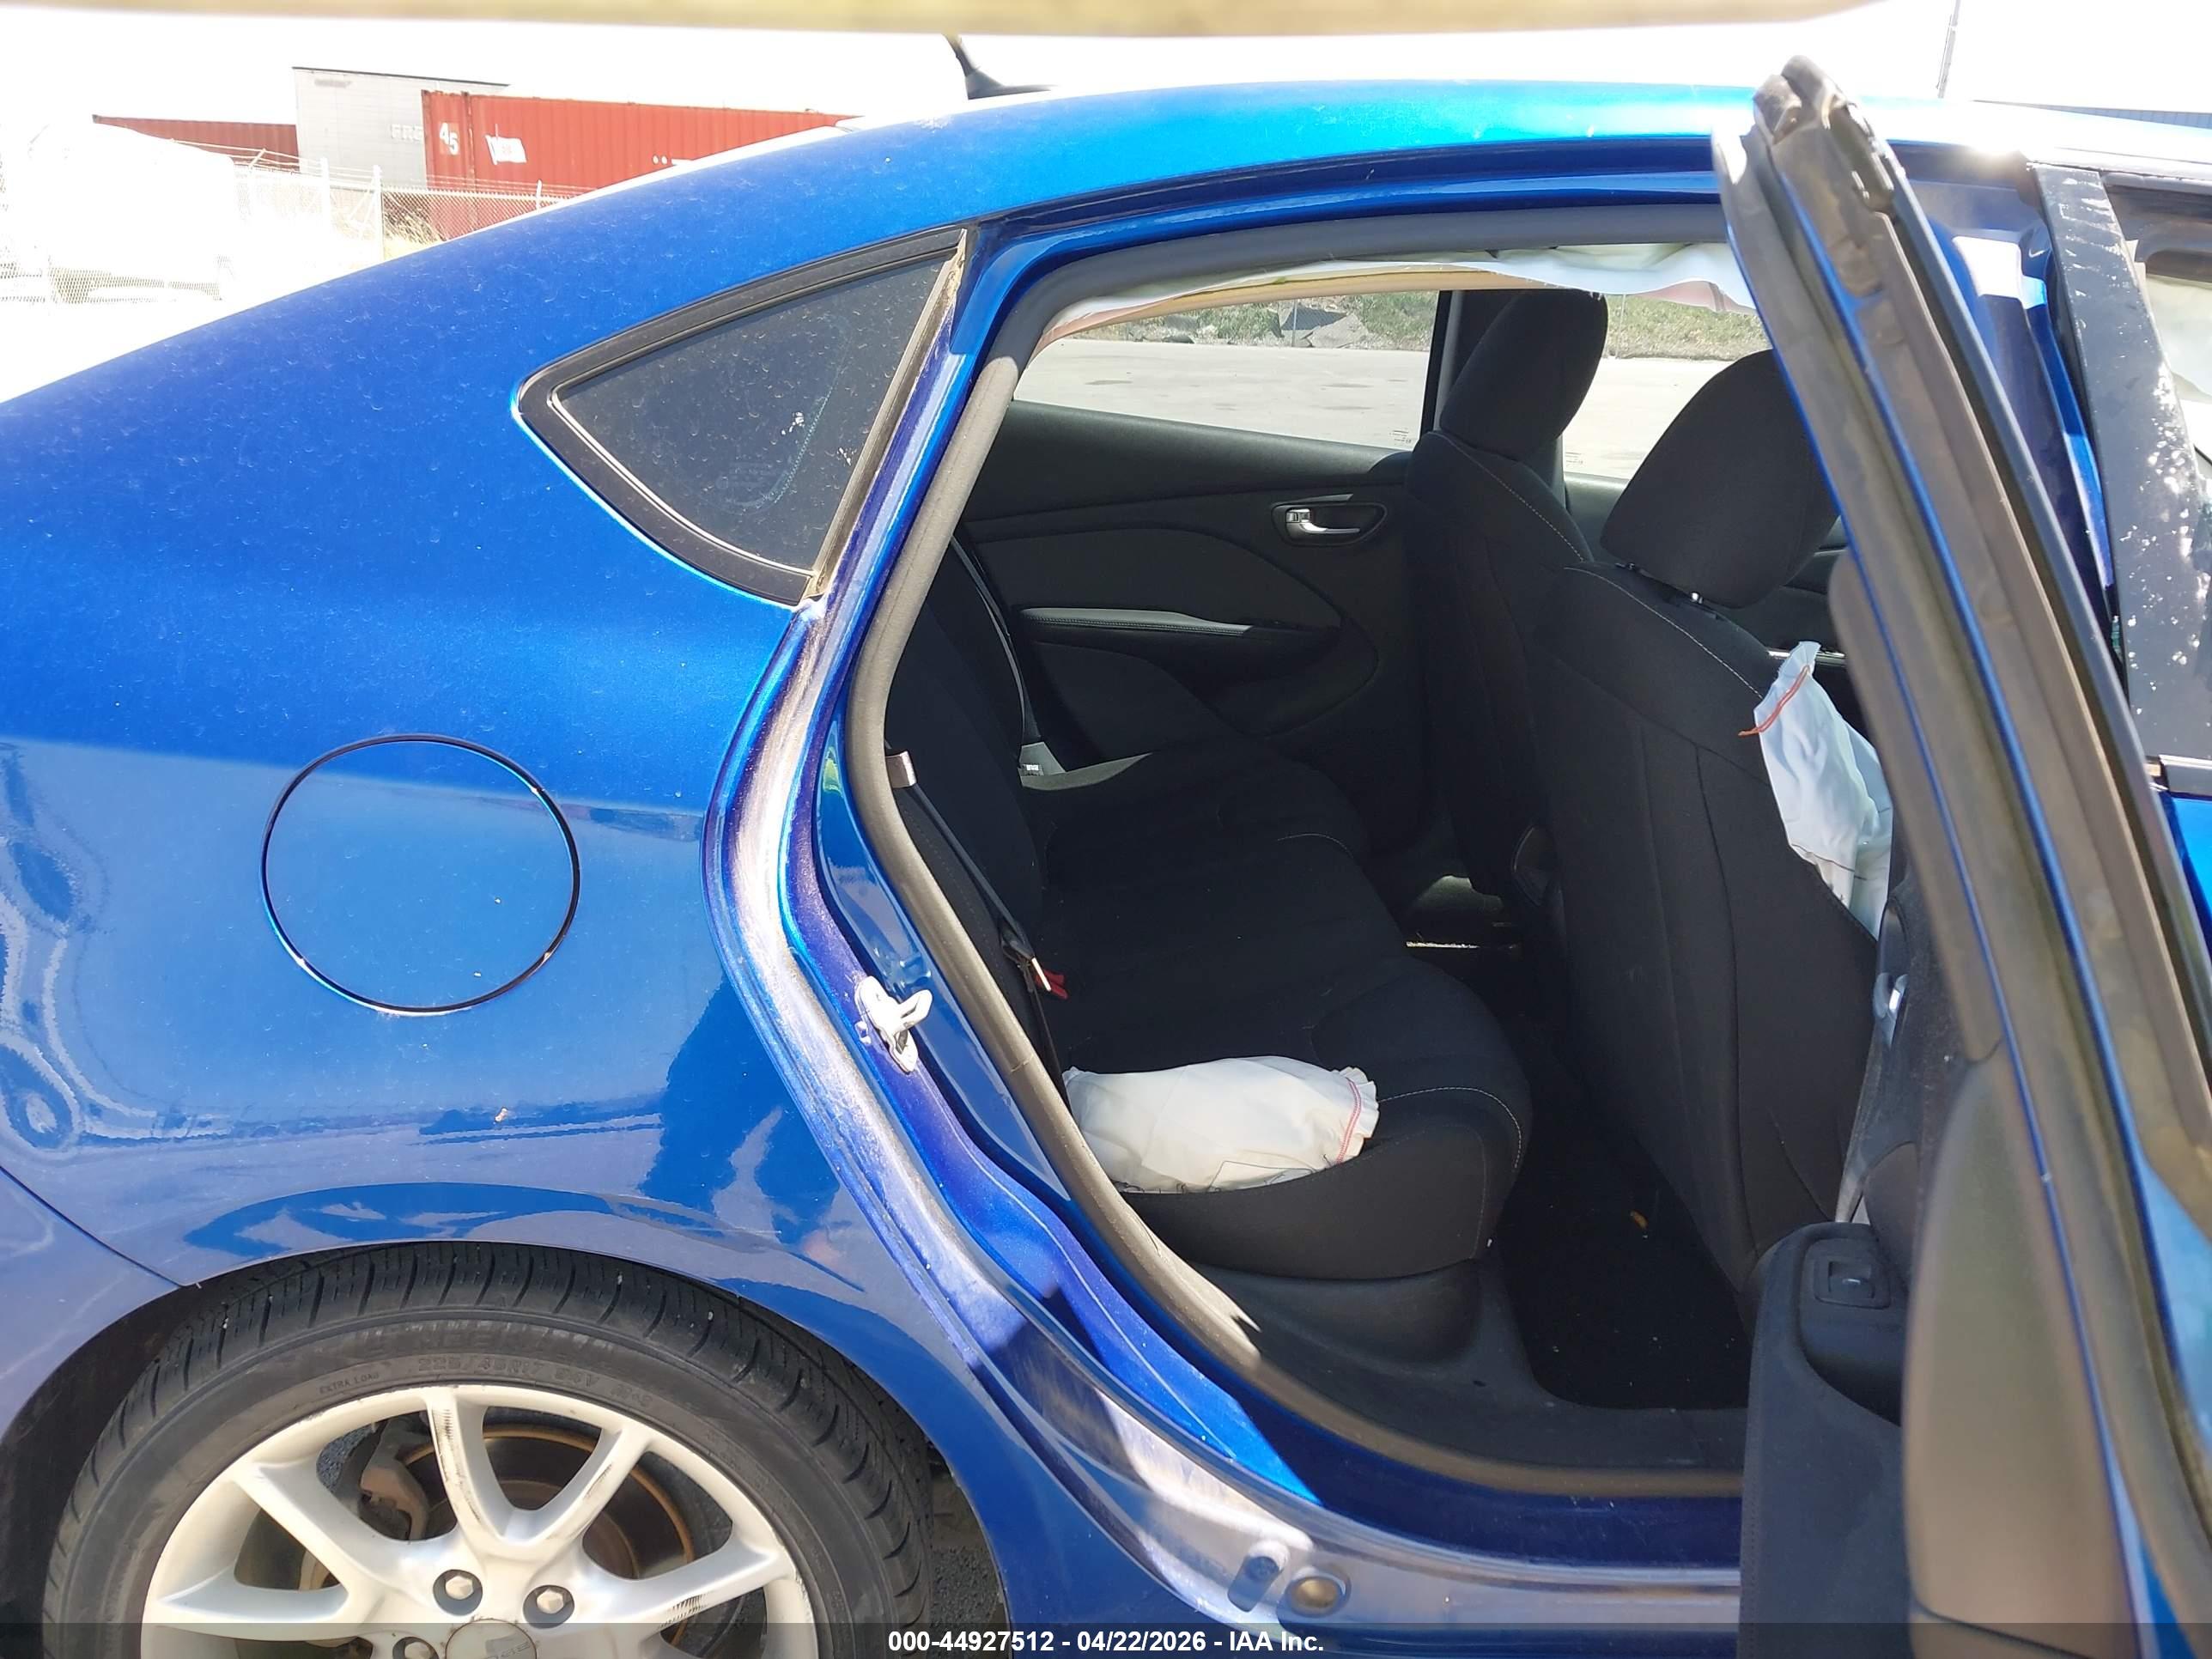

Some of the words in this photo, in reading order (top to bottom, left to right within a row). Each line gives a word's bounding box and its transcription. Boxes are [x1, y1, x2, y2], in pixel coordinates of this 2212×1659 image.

[440, 122, 459, 155] 45
[319, 1381, 350, 1395] EXTRA
[354, 1373, 380, 1385] LOAD
